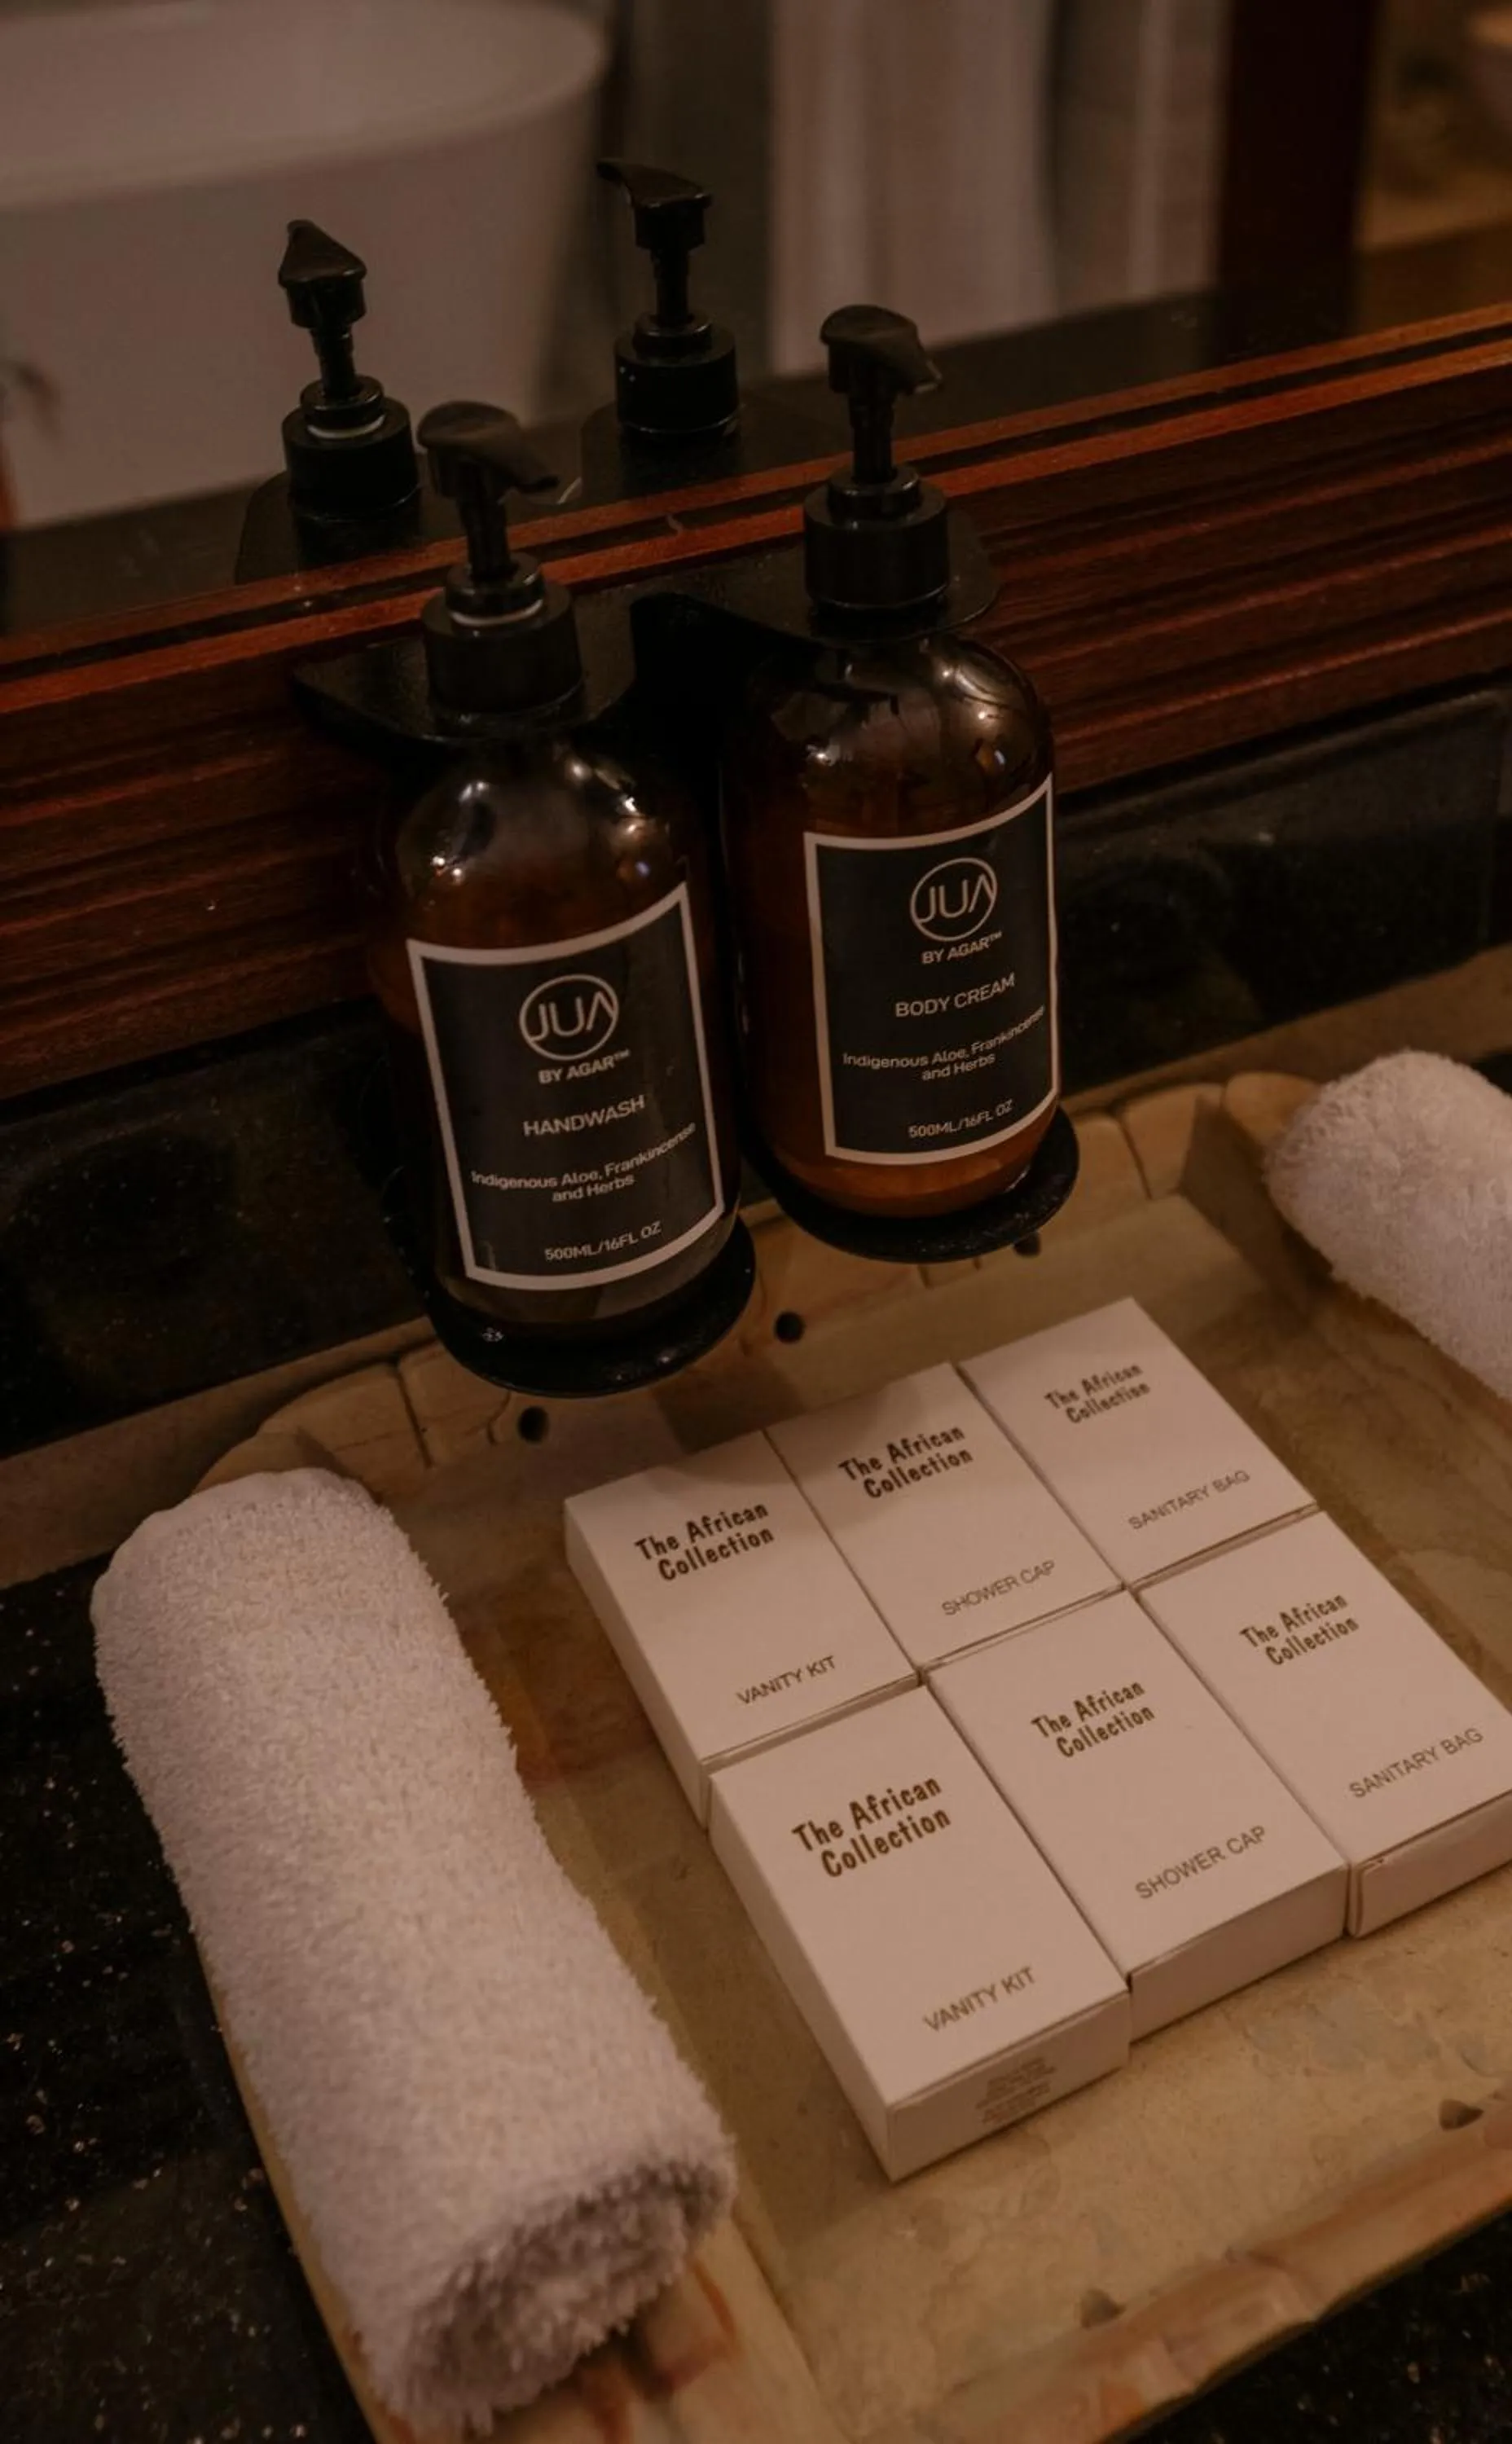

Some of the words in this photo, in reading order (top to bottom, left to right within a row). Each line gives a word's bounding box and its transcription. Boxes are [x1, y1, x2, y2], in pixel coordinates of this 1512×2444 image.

[921, 949, 943, 965] BY
[895, 997, 950, 1018] BODY
[954, 973, 1015, 1009] CREAM
[842, 1052, 929, 1069] Indigenous
[932, 1048, 969, 1066] Aloe,
[970, 1004, 1045, 1054] Frankincense
[538, 1068, 562, 1084] BY
[921, 1065, 950, 1081] and
[954, 1052, 995, 1075] Herbs
[523, 1094, 645, 1136] HANDWASH
[909, 1108, 993, 1139] 500ML/16FL
[996, 1098, 1013, 1117] OZ
[472, 1171, 557, 1190] Indigenous
[561, 1169, 603, 1185] Aloe,
[604, 1122, 696, 1176] Frankincense
[552, 1185, 583, 1202] and
[587, 1174, 635, 1198] Herbs
[545, 1234, 639, 1260] 500ML/16FL
[641, 1220, 662, 1240] OZ
[1045, 1387, 1079, 1410] The
[1082, 1363, 1142, 1395] African
[1066, 1382, 1150, 1423] Collection
[838, 1457, 882, 1482] The
[887, 1426, 965, 1465] African
[864, 1448, 974, 1499] Collection
[1128, 1484, 1211, 1530] SANITARY
[1213, 1469, 1250, 1493] BAG
[635, 1534, 680, 1563] The
[686, 1503, 769, 1545] African
[658, 1525, 775, 1582] Collection
[942, 1574, 1018, 1616] SHOWER
[1021, 1559, 1056, 1585] CAP
[1240, 1624, 1279, 1648] The
[1281, 1594, 1348, 1632] African
[1265, 1615, 1360, 1666] Collection
[736, 1668, 803, 1705] VANITY
[806, 1655, 837, 1677] KIT
[1031, 1712, 1072, 1738] The
[1074, 1681, 1145, 1722] African
[1057, 1703, 1155, 1758] Collection
[1349, 1746, 1441, 1798] SANITARY
[1440, 1728, 1483, 1756] BAG
[791, 1819, 844, 1853] The
[849, 1777, 942, 1830] African
[820, 1806, 952, 1877] Collection
[1136, 1847, 1224, 1900] SHOWER
[1227, 1825, 1267, 1856] CAP
[924, 1986, 998, 2033] VANITY
[1002, 1967, 1036, 1994] KIT
